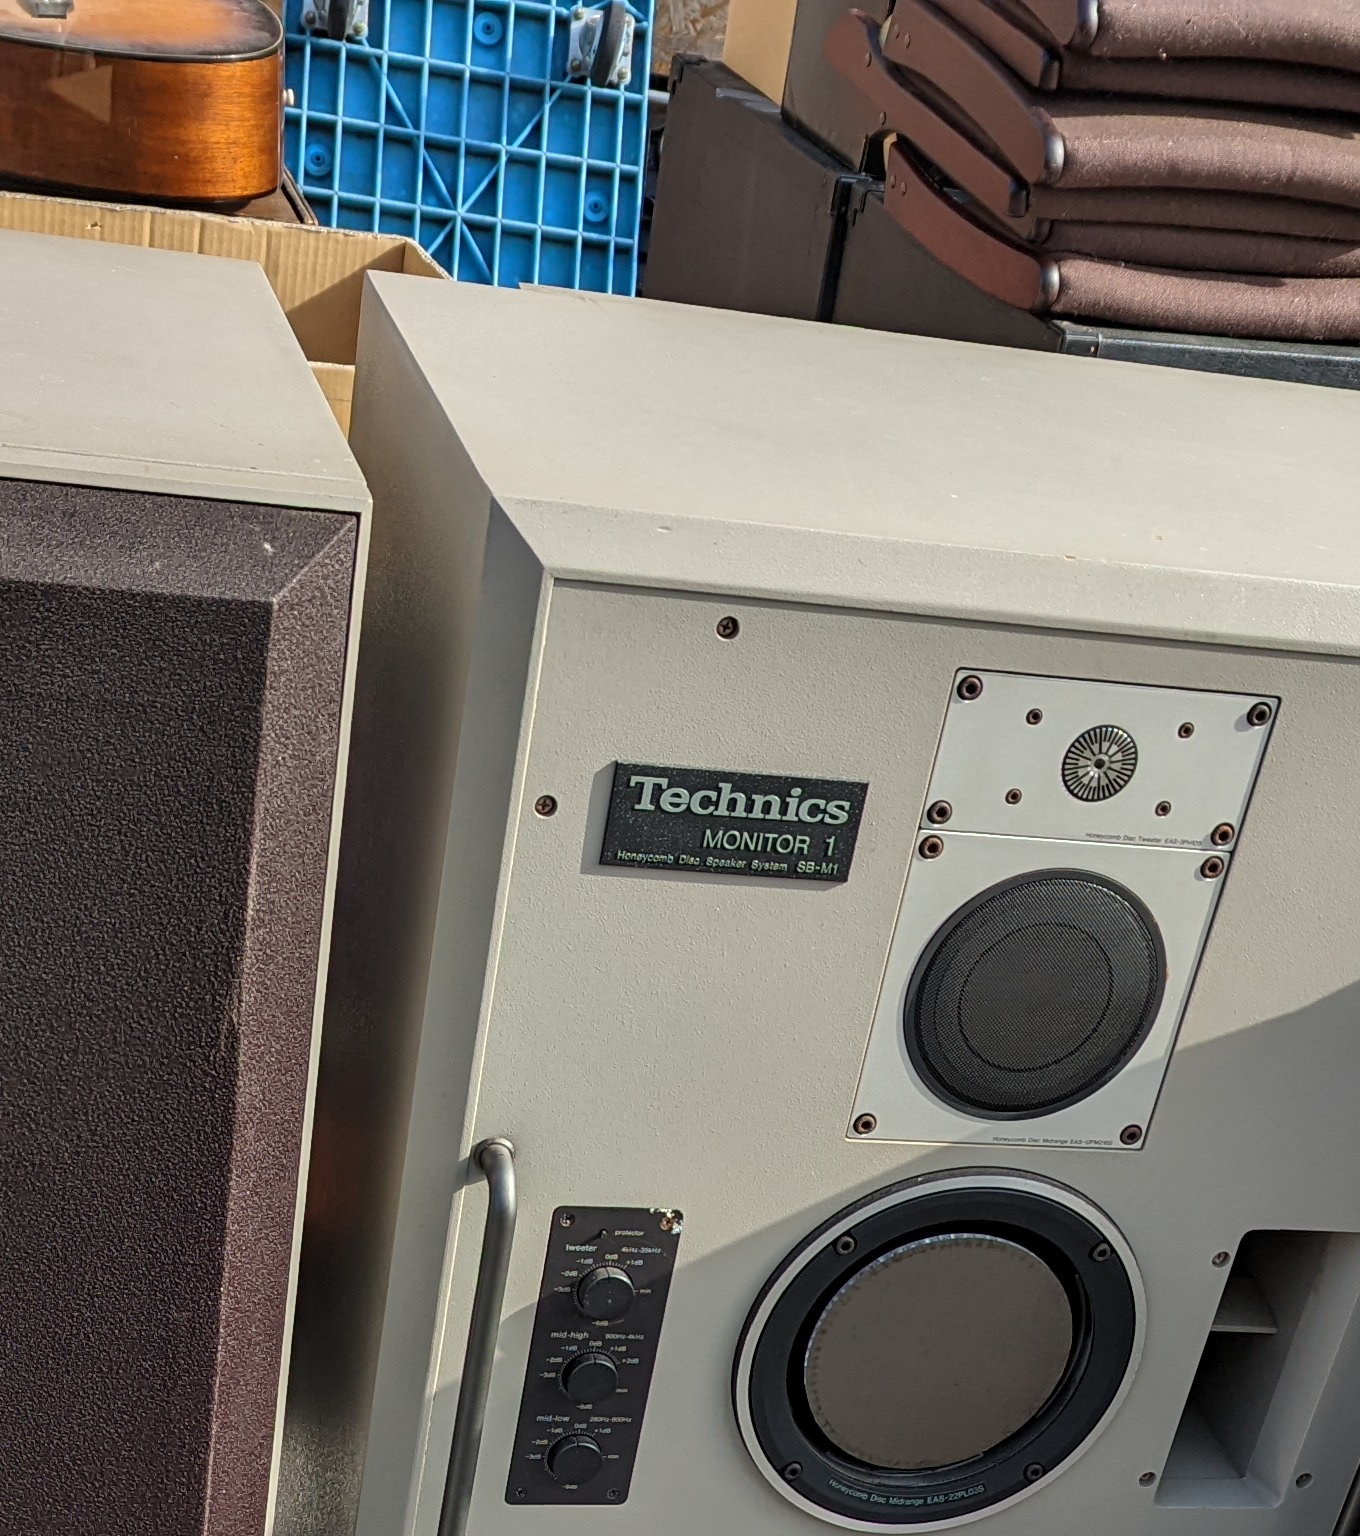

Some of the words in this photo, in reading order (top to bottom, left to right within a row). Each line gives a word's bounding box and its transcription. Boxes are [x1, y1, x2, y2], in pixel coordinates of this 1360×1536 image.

[629, 775, 851, 825] Technics
[703, 829, 811, 855] MONITOR
[825, 836, 836, 857] 1
[617, 850, 674, 865] Honeycomb
[678, 854, 700, 866] Disc
[706, 857, 746, 870] Speaker
[751, 859, 788, 873] System
[796, 862, 839, 876] SB-M1
[565, 1243, 597, 1252] tweeter
[551, 1332, 589, 1340] mid-high
[828, 1478, 869, 1501] Honeycomb
[870, 1494, 887, 1504] Disc
[889, 1497, 925, 1506] Midrange
